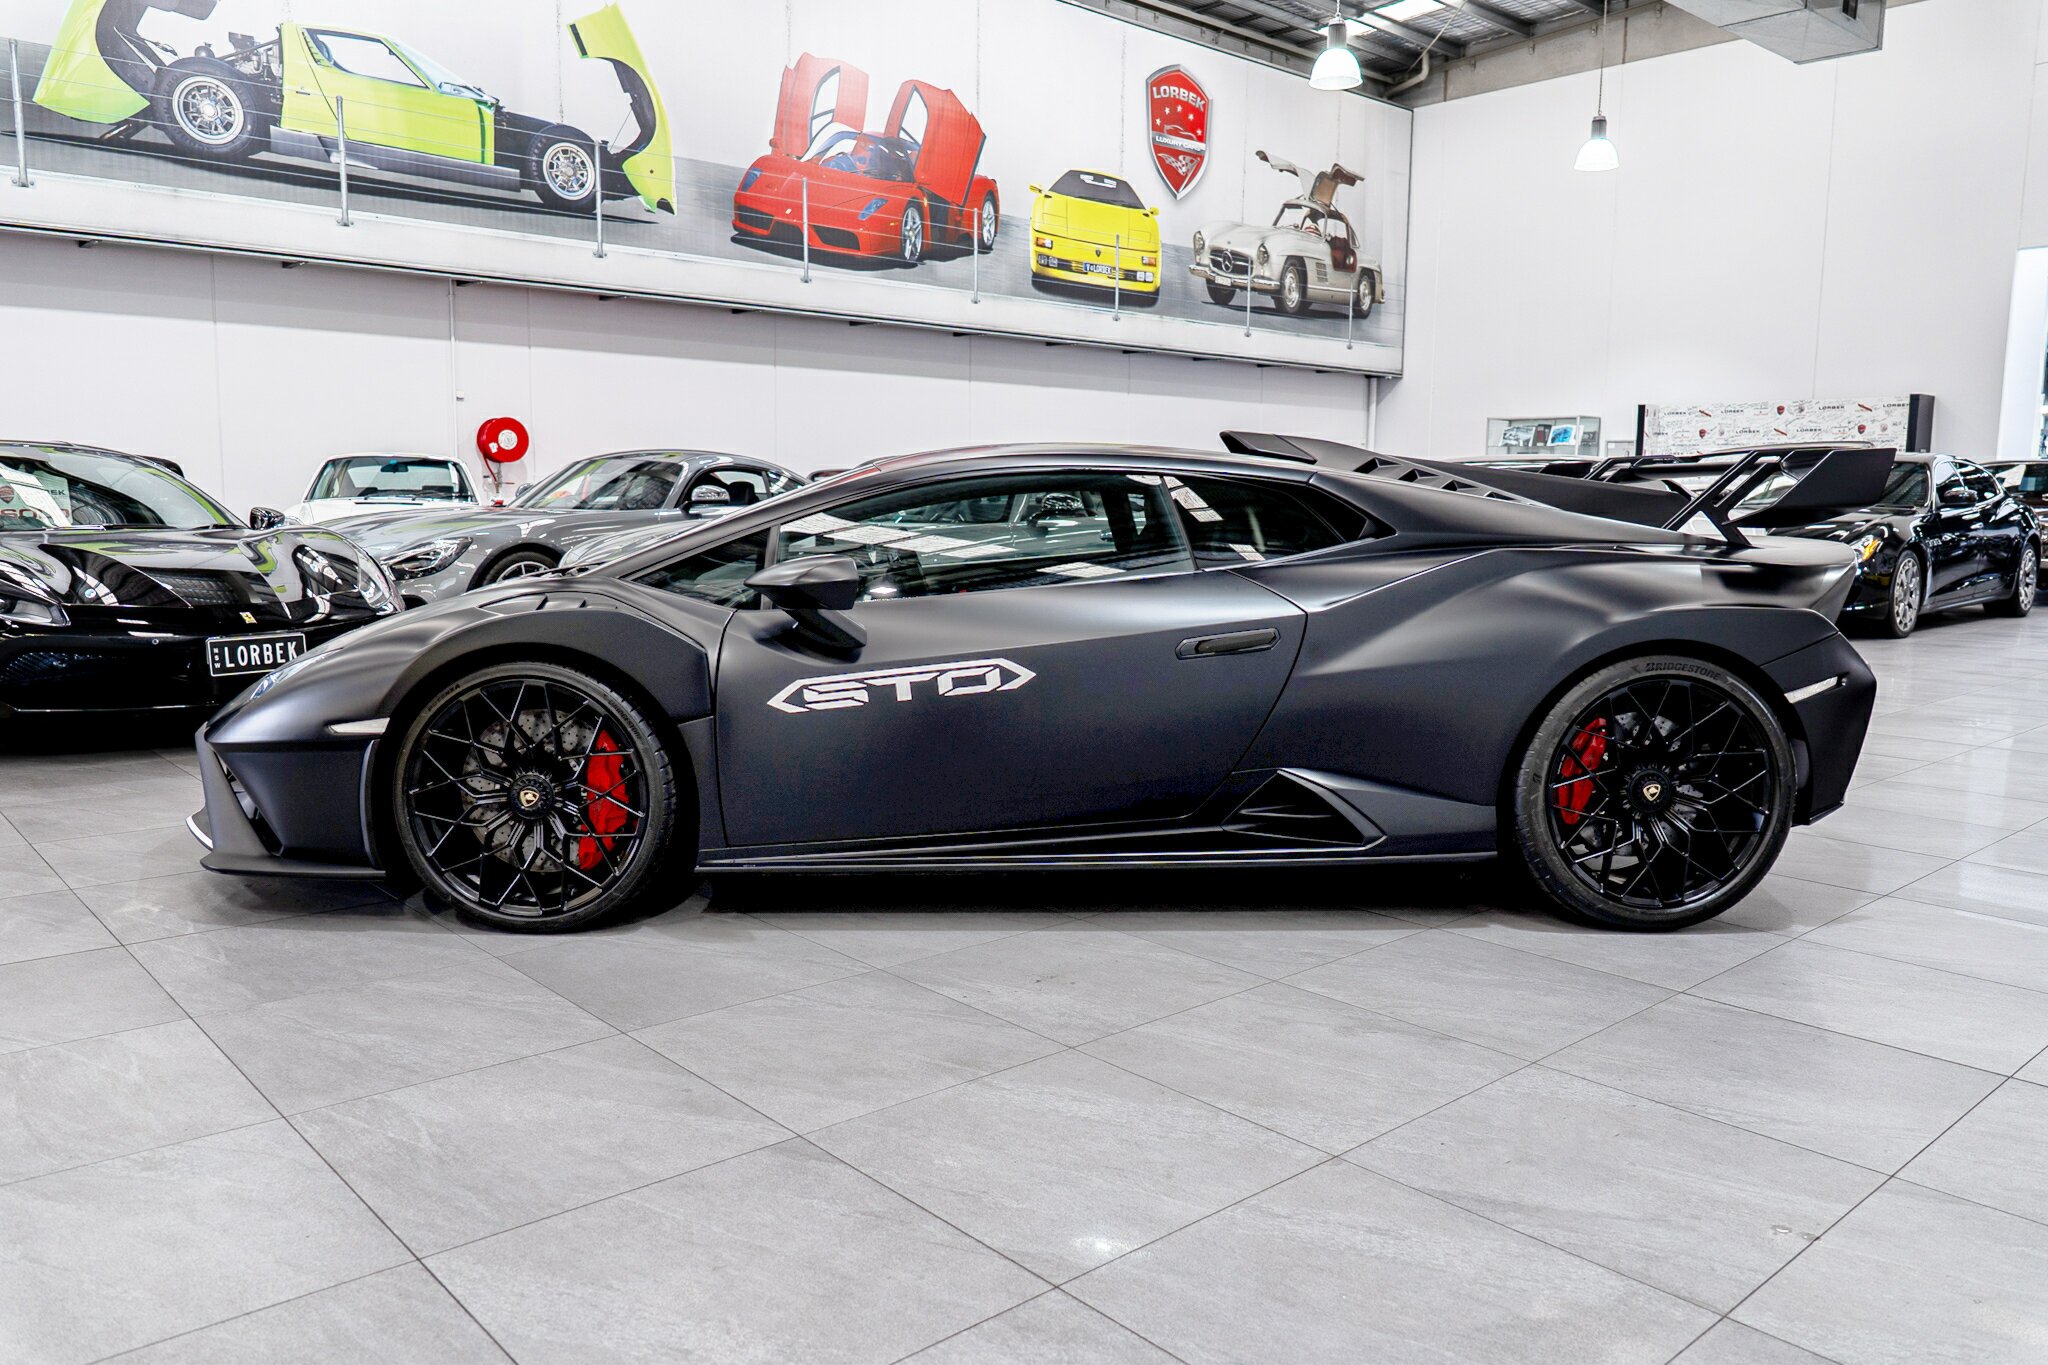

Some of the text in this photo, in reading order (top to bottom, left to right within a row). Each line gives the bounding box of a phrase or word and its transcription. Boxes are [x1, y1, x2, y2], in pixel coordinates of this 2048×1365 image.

[1152, 85, 1207, 112] LORBEK
[224, 641, 298, 668] LORBEK
[1645, 662, 1722, 680] BRIDGESTONE
[802, 666, 1001, 710] STO
